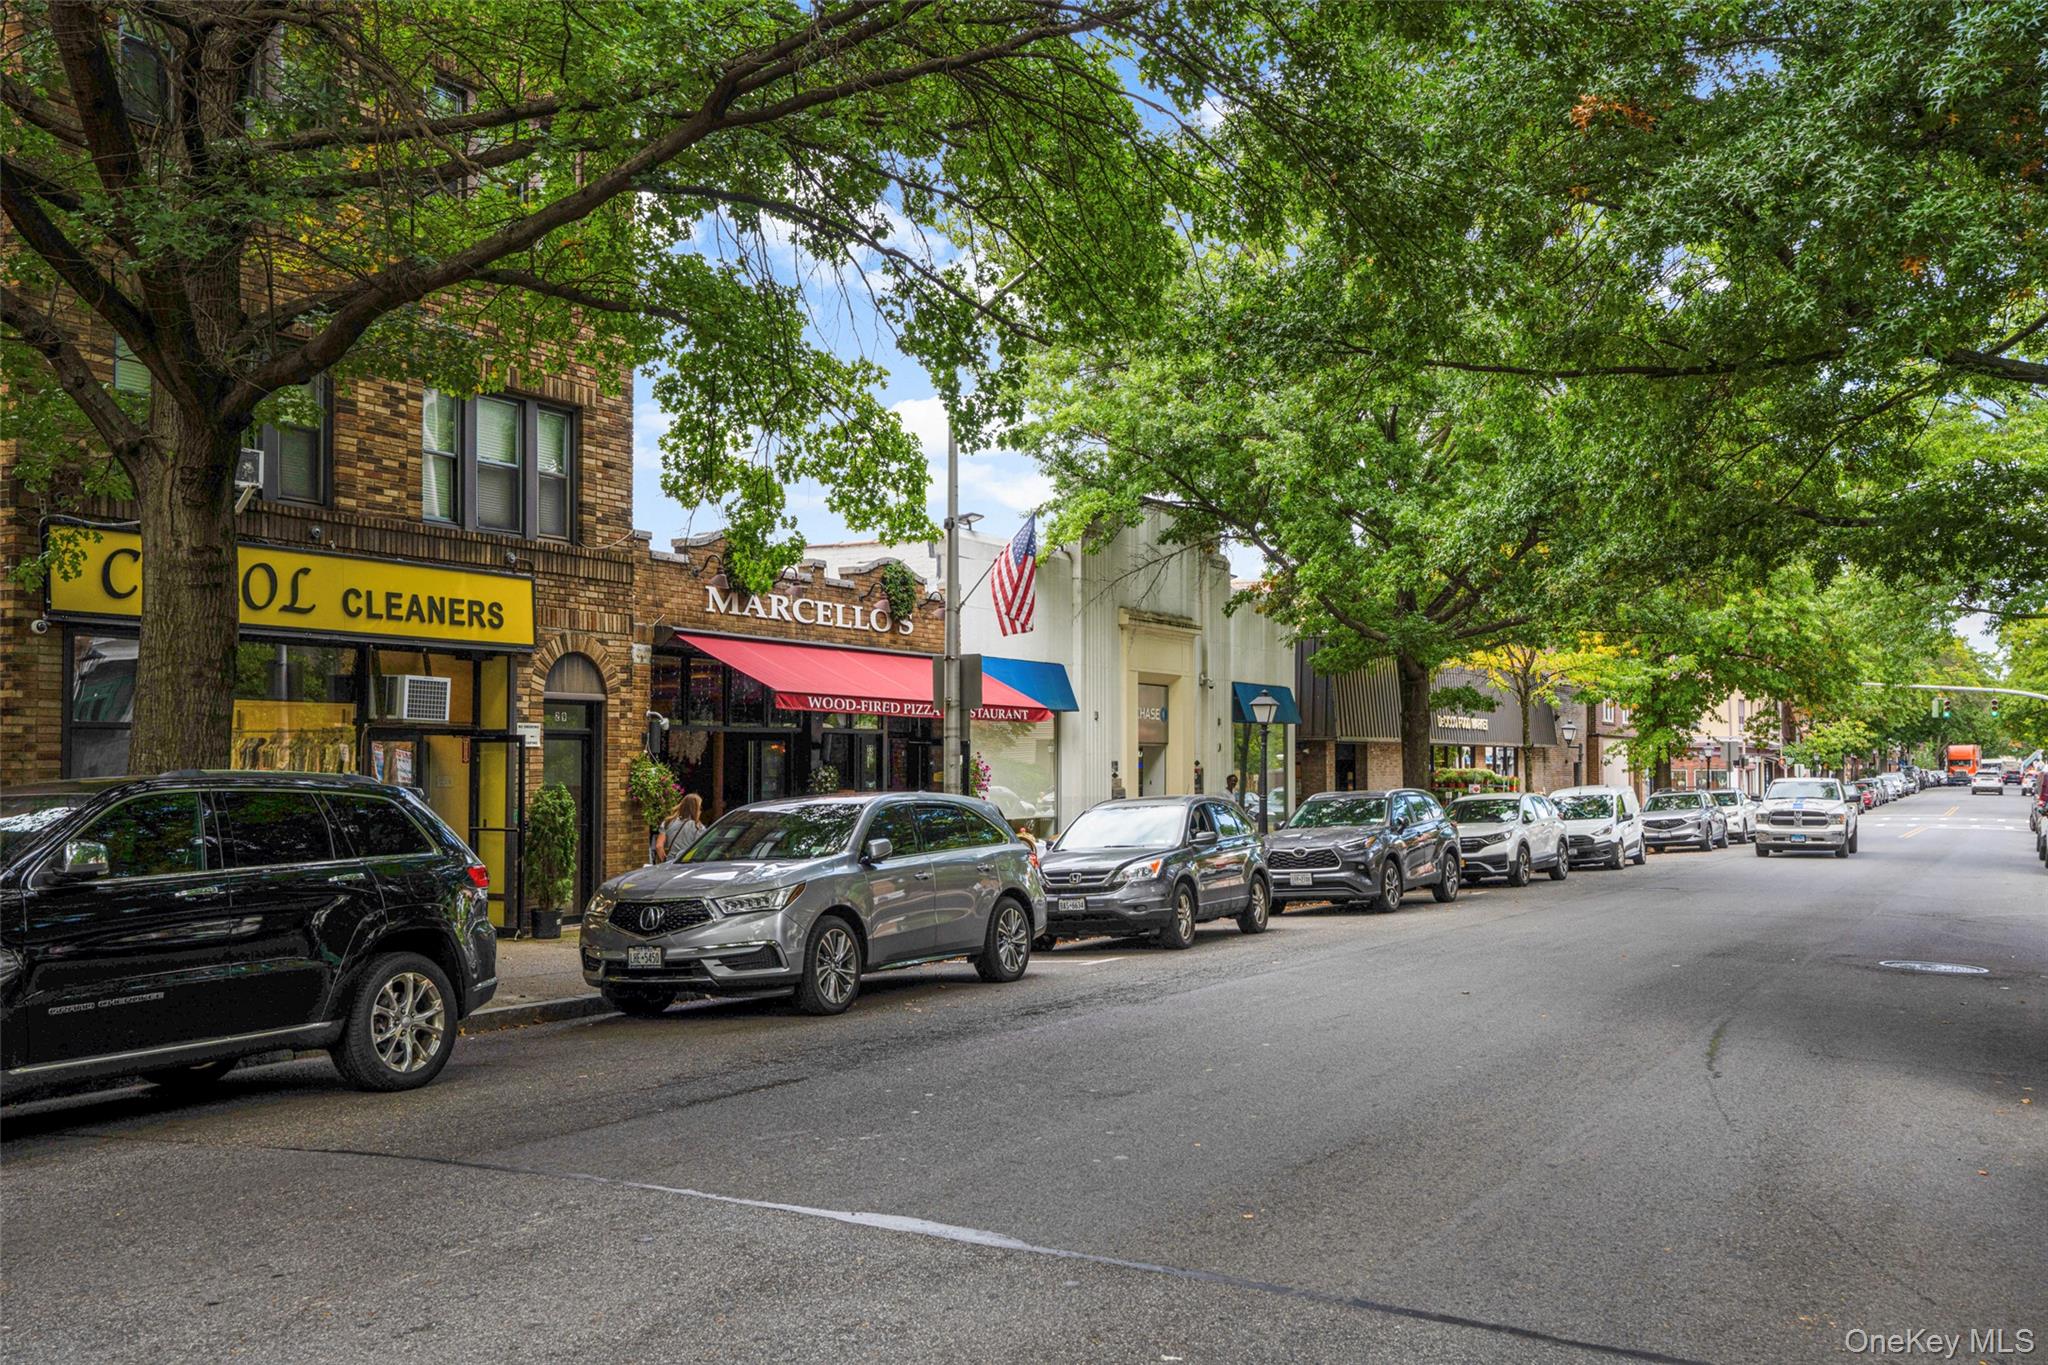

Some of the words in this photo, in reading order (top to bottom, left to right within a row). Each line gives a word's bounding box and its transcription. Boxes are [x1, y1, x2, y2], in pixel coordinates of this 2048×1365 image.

[342, 587, 505, 630] CLEANERS
[705, 585, 914, 635] MARCELLOS
[808, 696, 900, 714] WOOD-FIRED
[1137, 708, 1160, 720] HASE
